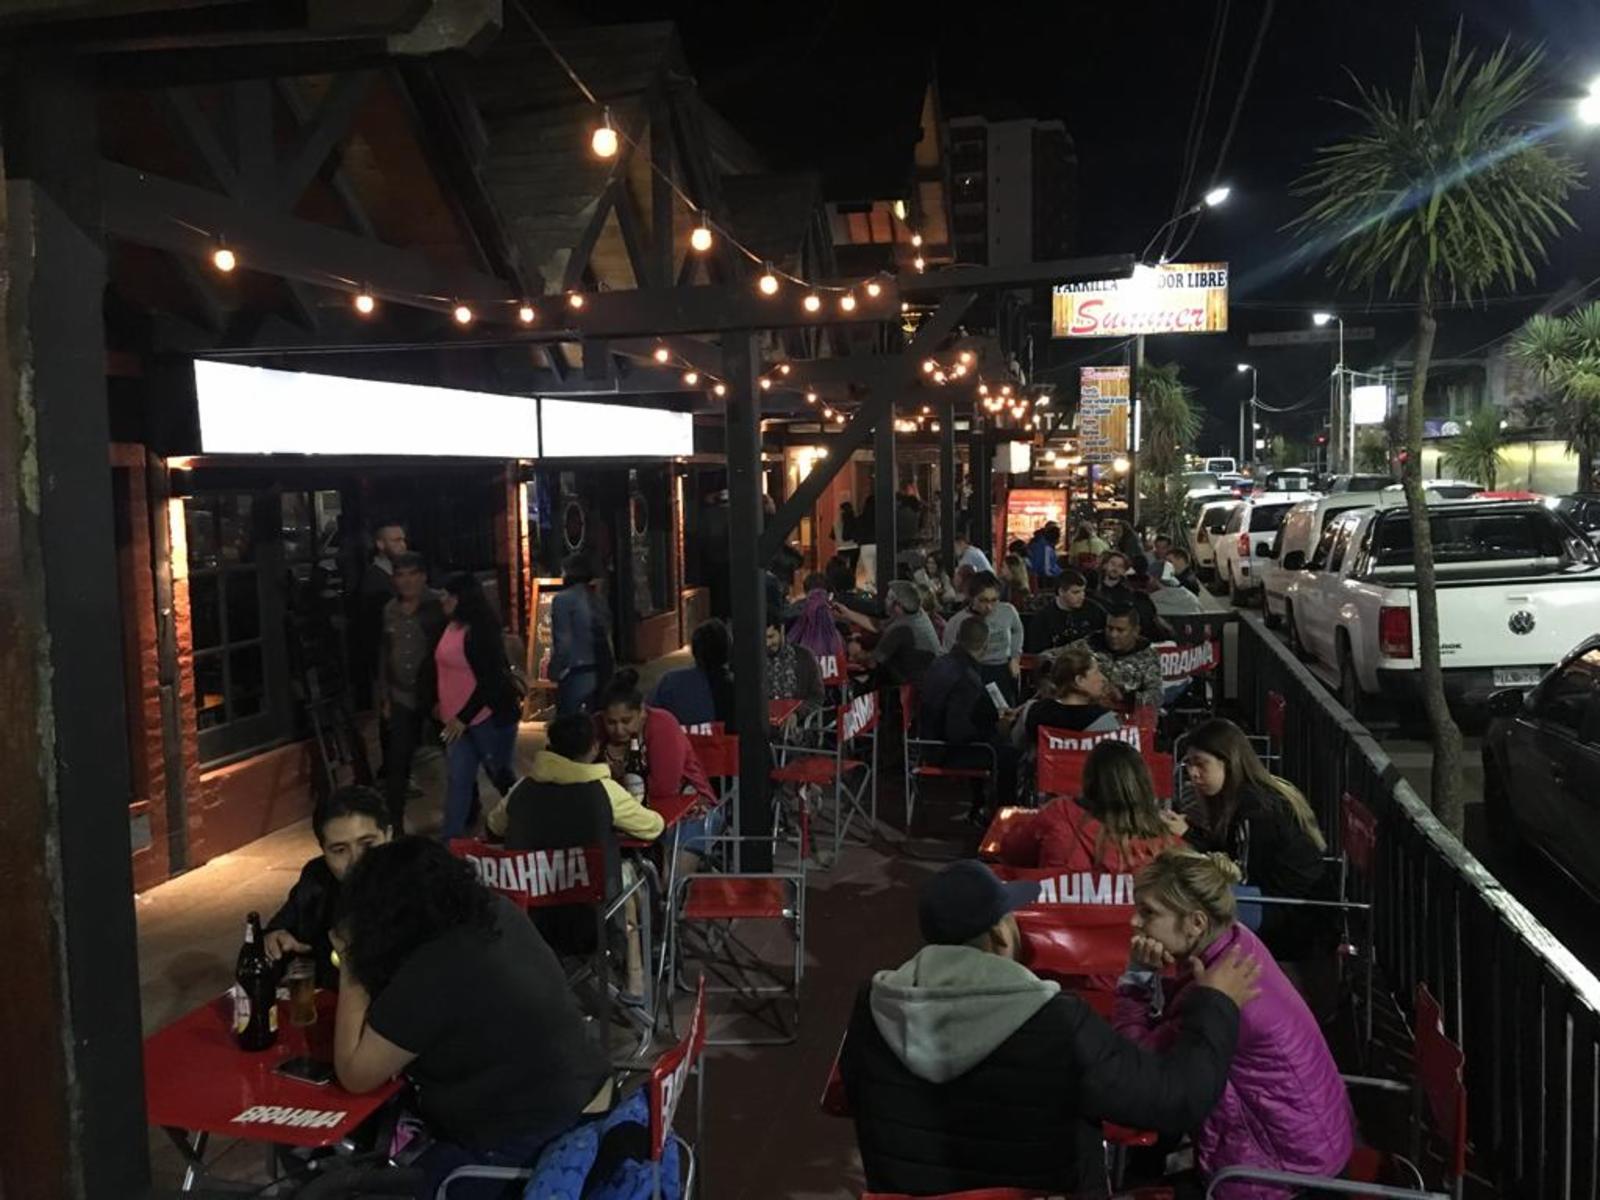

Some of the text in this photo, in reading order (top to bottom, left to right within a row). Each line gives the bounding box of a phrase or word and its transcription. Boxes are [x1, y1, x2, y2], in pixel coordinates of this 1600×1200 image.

[1188, 271, 1226, 288] LIBRE
[1160, 640, 1213, 676] BRAHMA
[1037, 872, 1135, 906] AHMA
[231, 1105, 348, 1129] BRAHMA
